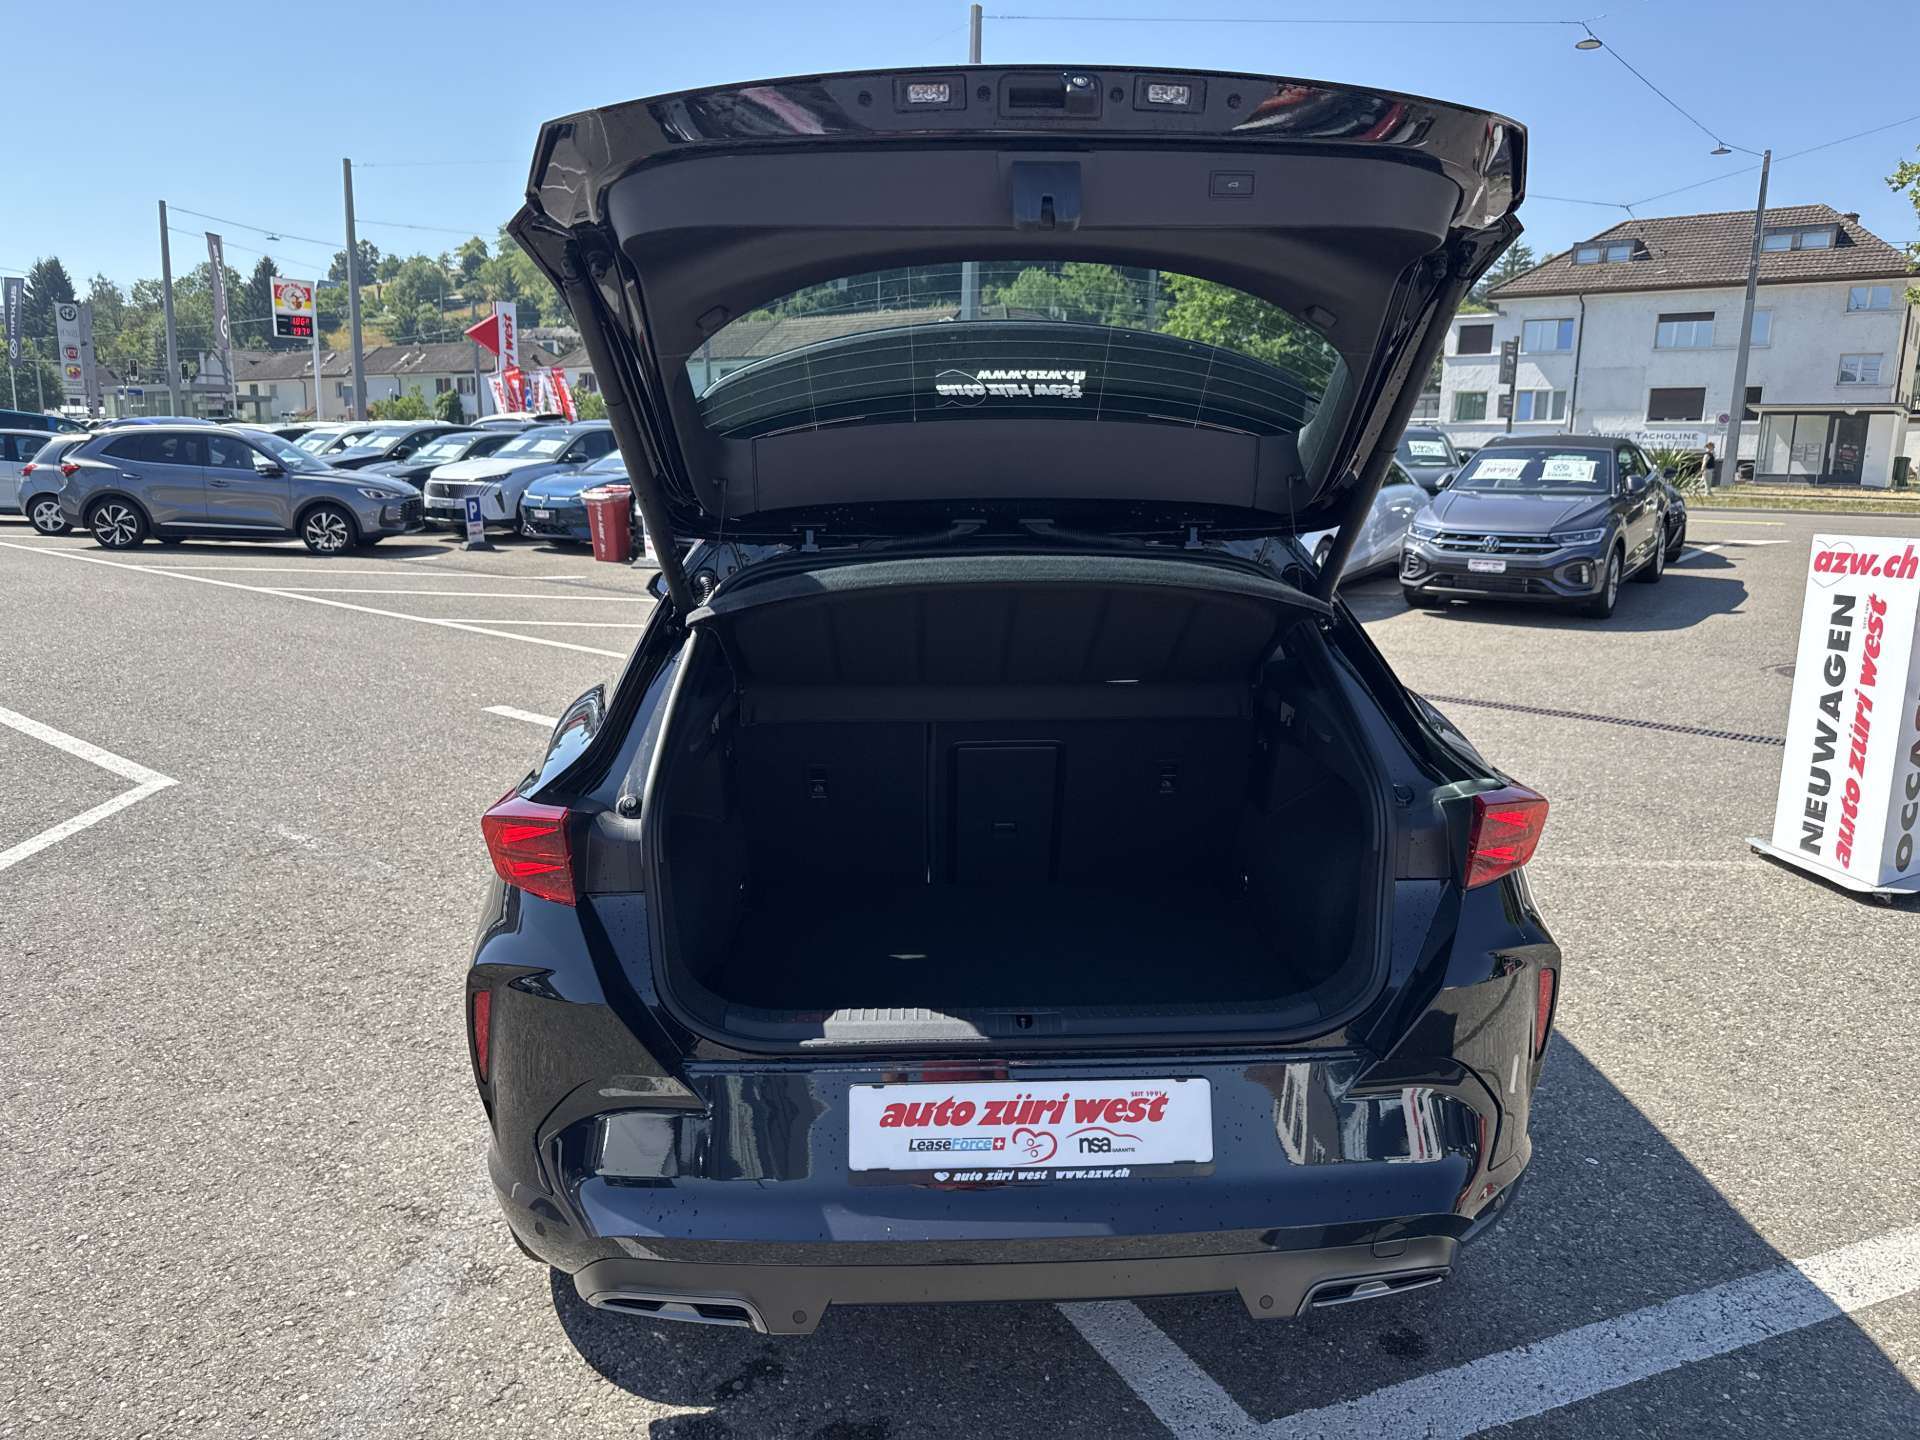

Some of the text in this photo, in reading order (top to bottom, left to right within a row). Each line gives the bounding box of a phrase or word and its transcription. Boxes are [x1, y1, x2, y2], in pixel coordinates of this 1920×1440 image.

[1635, 431, 1699, 441] TACHOLINE
[469, 501, 478, 519] P
[1813, 545, 1919, 580] azw.ch
[1799, 594, 1857, 857] NEUWAGEN
[1834, 592, 1888, 869] auto züri west
[879, 1091, 1170, 1128] auto züri west
[908, 1137, 992, 1152] LeaseForce
[1079, 1137, 1111, 1153] nsa
[953, 1168, 1130, 1182] auto züri west www.azw.ch
